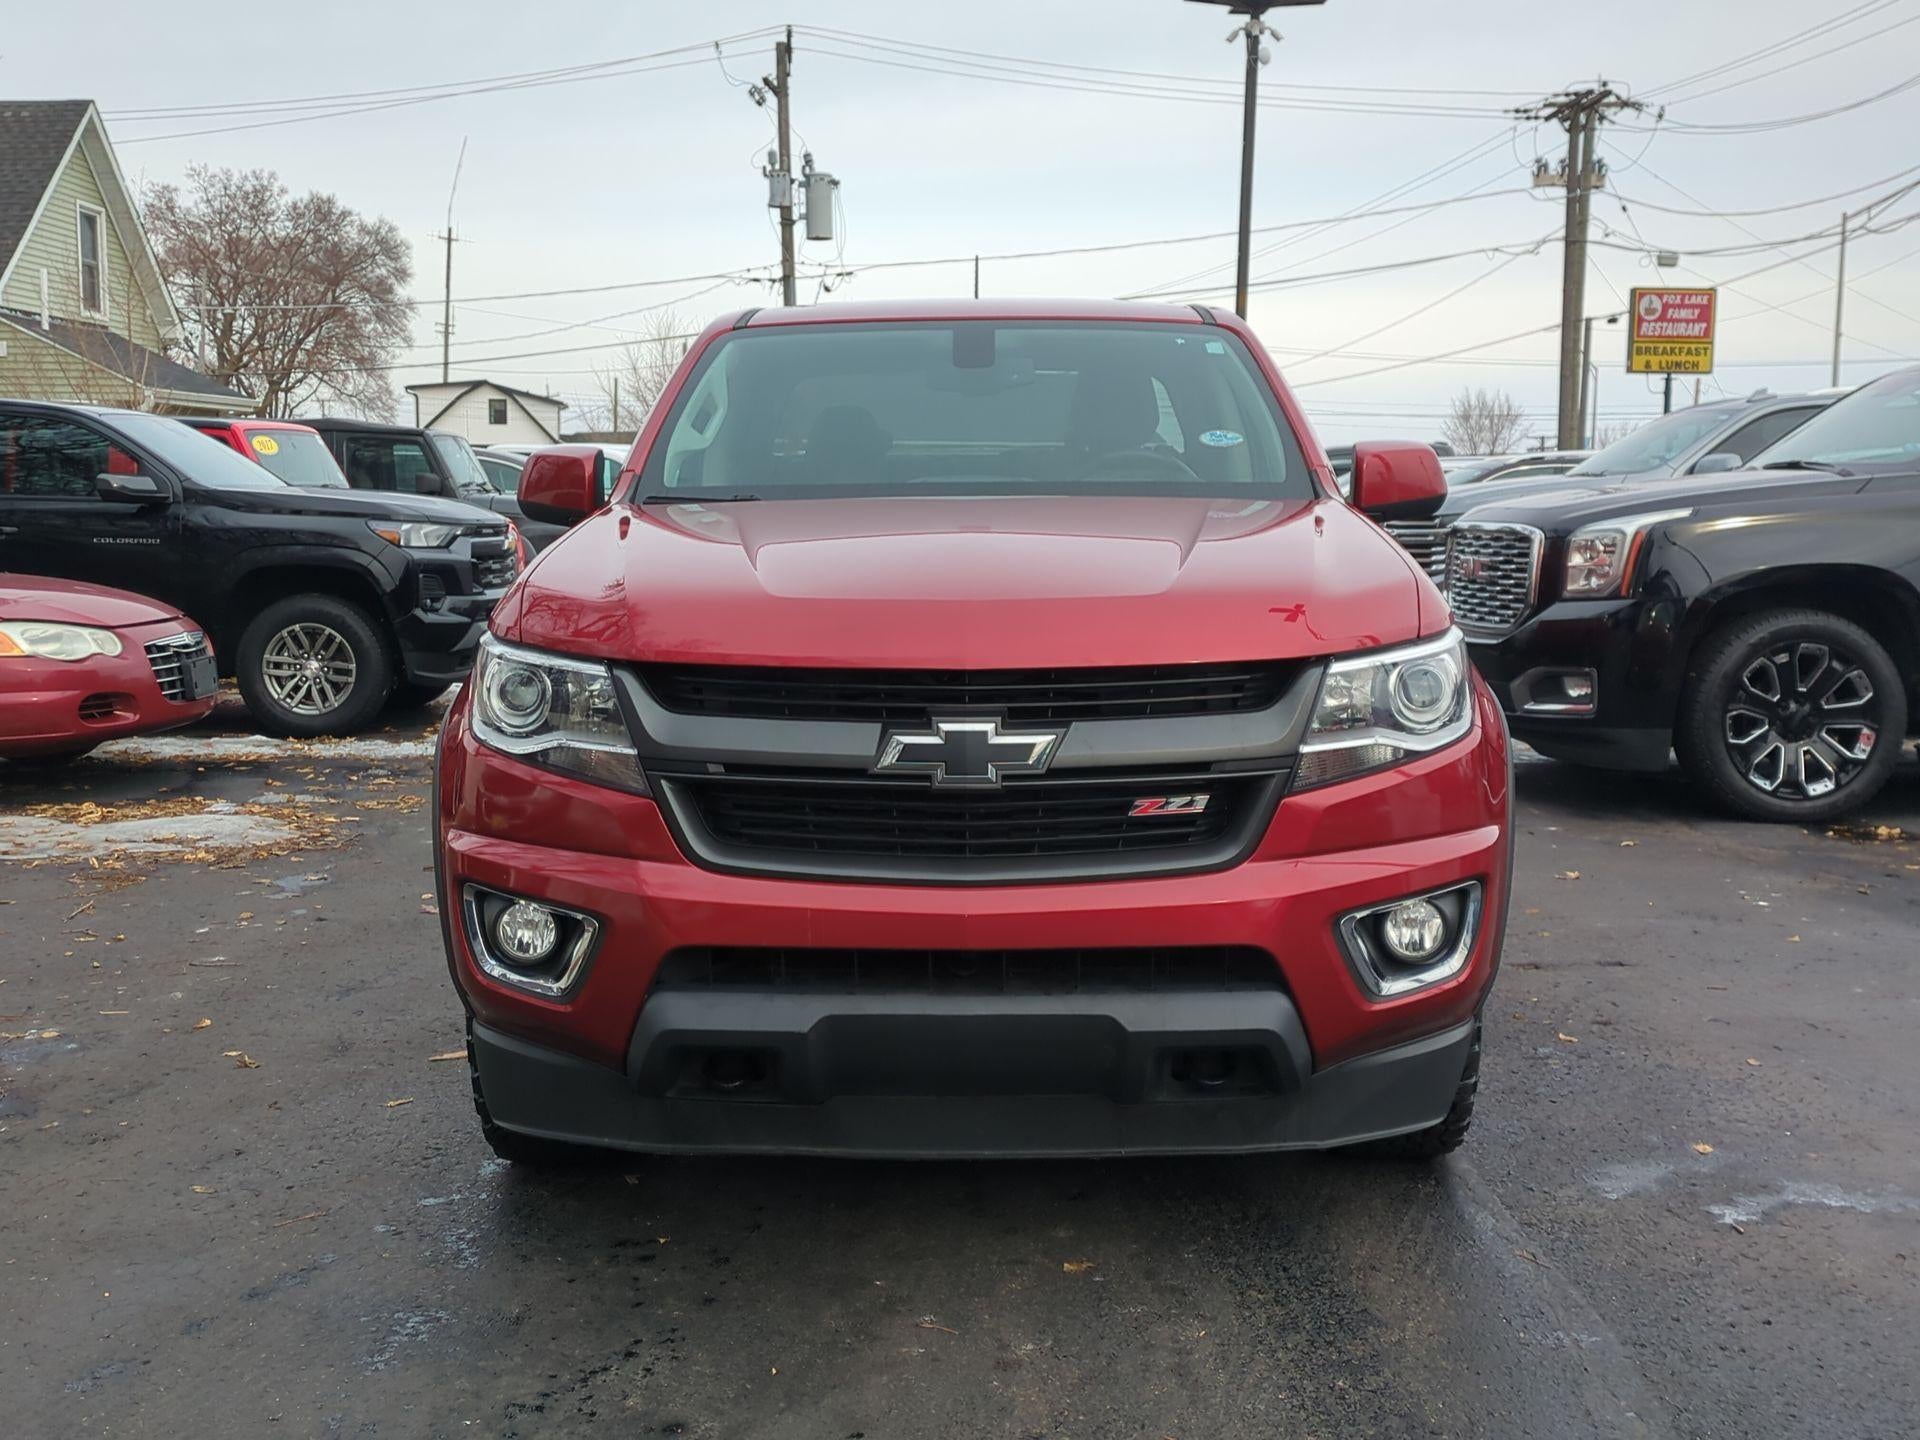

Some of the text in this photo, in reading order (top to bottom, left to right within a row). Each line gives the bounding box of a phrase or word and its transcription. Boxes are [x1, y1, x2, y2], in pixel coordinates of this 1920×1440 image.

[1662, 294, 1710, 304] FOX LAKE
[1667, 308, 1700, 319] FAMILY
[1640, 322, 1707, 336] RESTAURANT
[1635, 346, 1710, 356] BREAKFAST
[1644, 360, 1700, 370] & LUNCH
[256, 439, 274, 451] 2017
[1128, 795, 1211, 817] Z71
